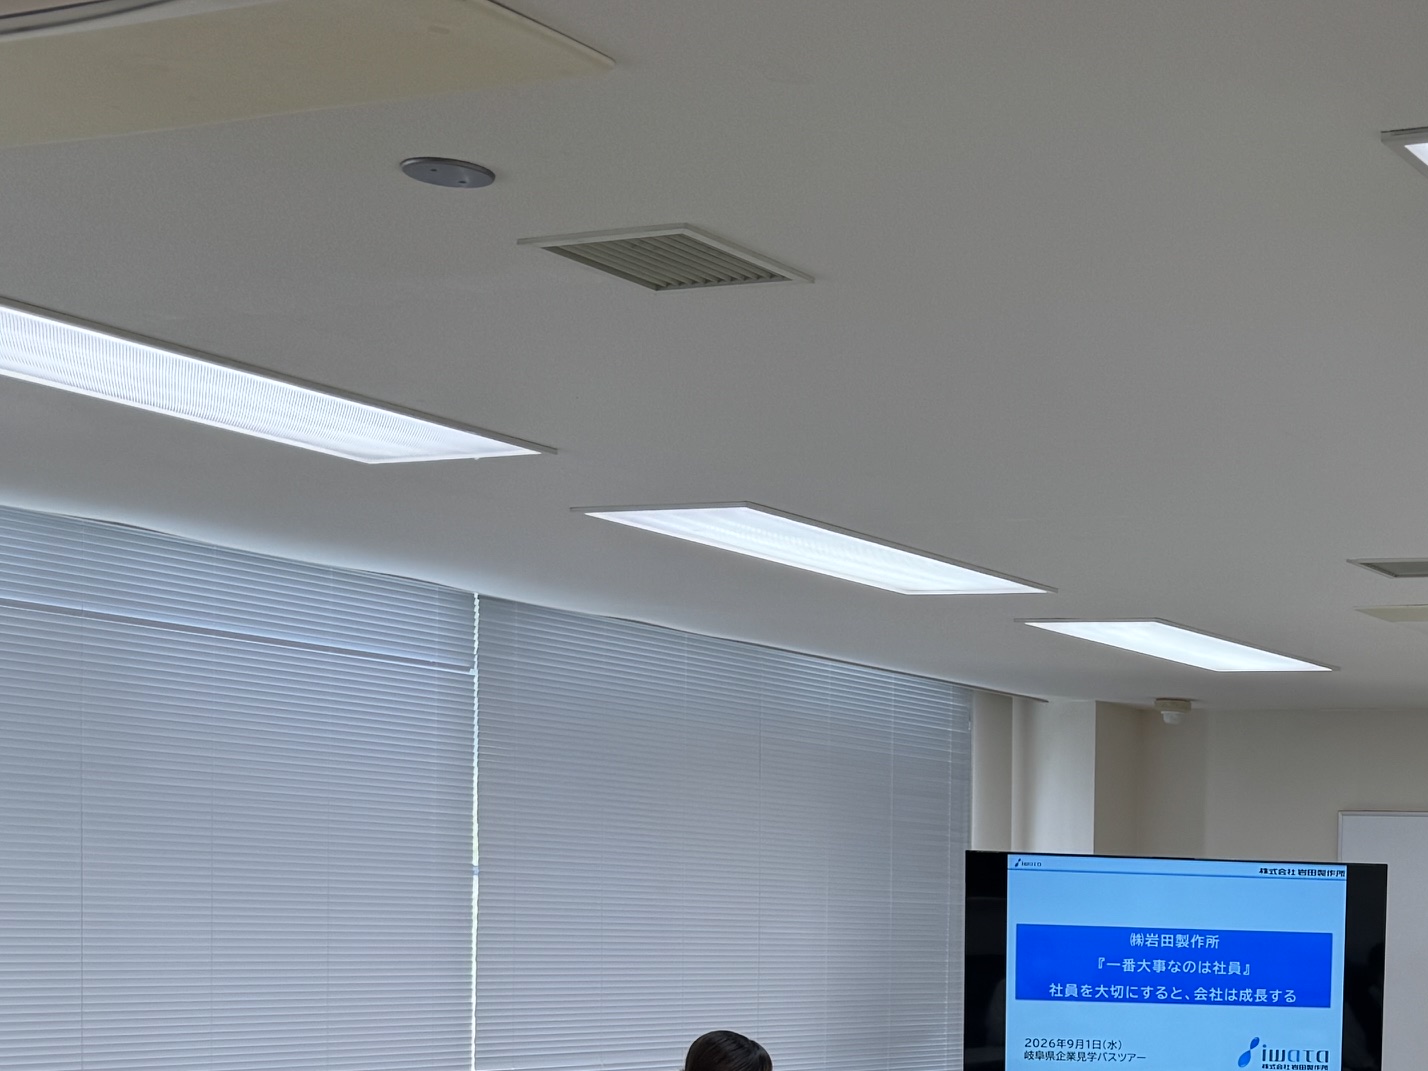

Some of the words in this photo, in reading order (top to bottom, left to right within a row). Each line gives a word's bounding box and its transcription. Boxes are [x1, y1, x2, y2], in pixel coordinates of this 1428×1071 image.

[1098, 957, 1251, 976] 『一番大事なのは社員』
[1049, 982, 1296, 1003] 社員を大切にすると、会社は成長する
[1024, 1037, 1122, 1051] 2026年9月1日(水)
[1262, 1044, 1329, 1063] iwata
[1024, 1050, 1147, 1062] 岐阜県企業見学バスツアー
